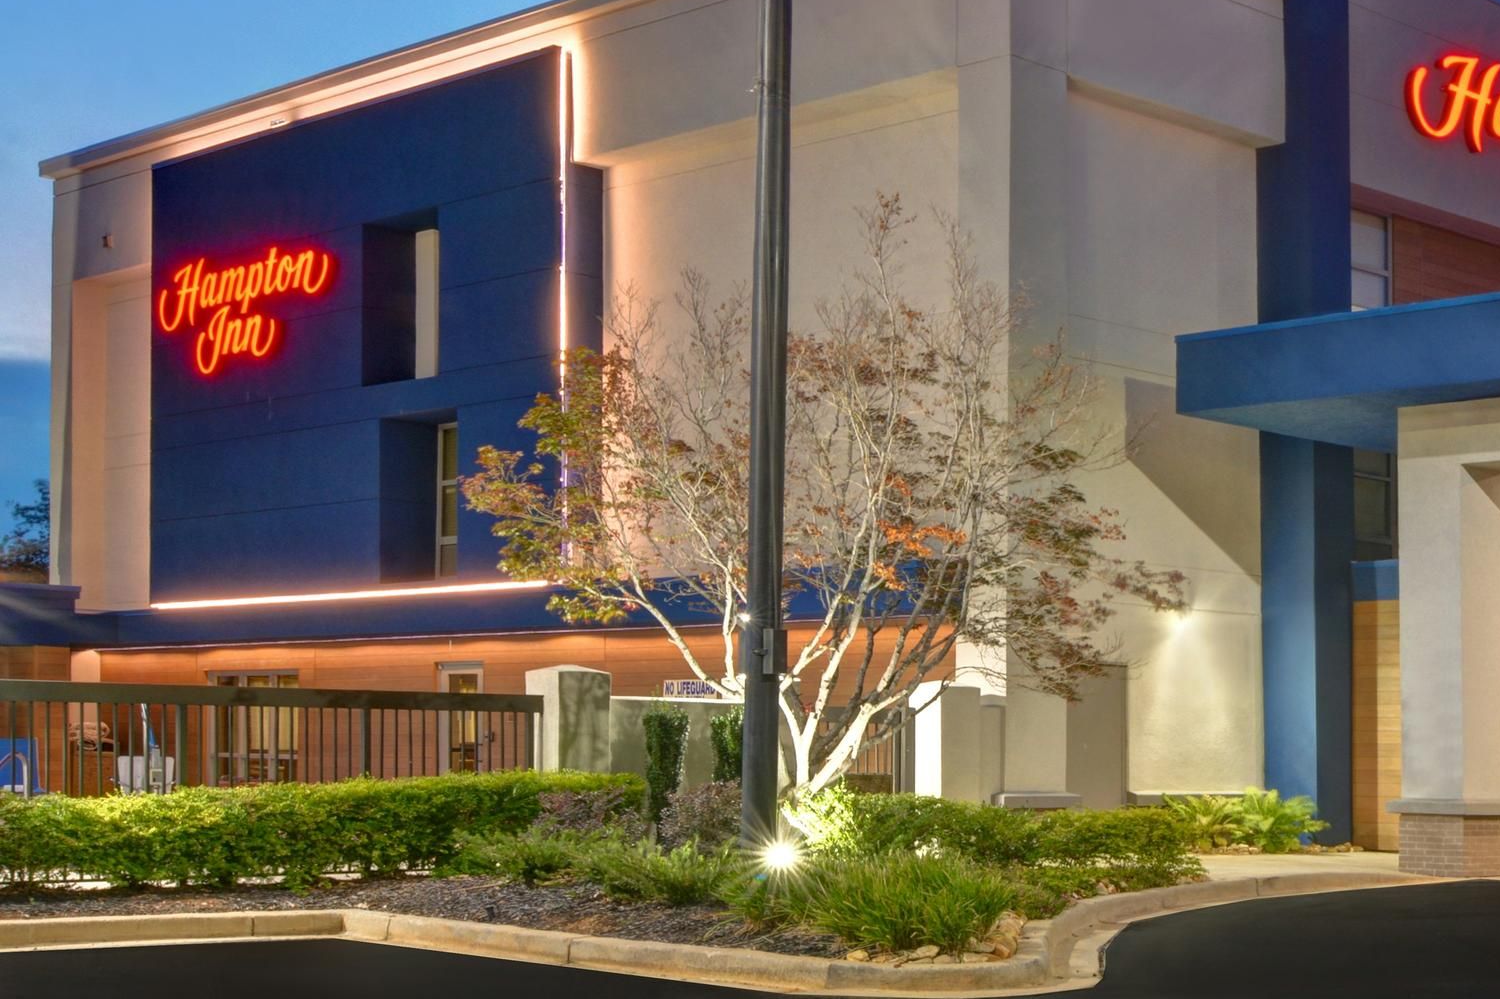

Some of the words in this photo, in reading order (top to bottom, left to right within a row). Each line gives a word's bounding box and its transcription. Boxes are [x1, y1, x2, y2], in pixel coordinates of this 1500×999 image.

[160, 246, 328, 332] Hampton
[196, 305, 275, 375] Inn
[664, 681, 674, 695] NO
